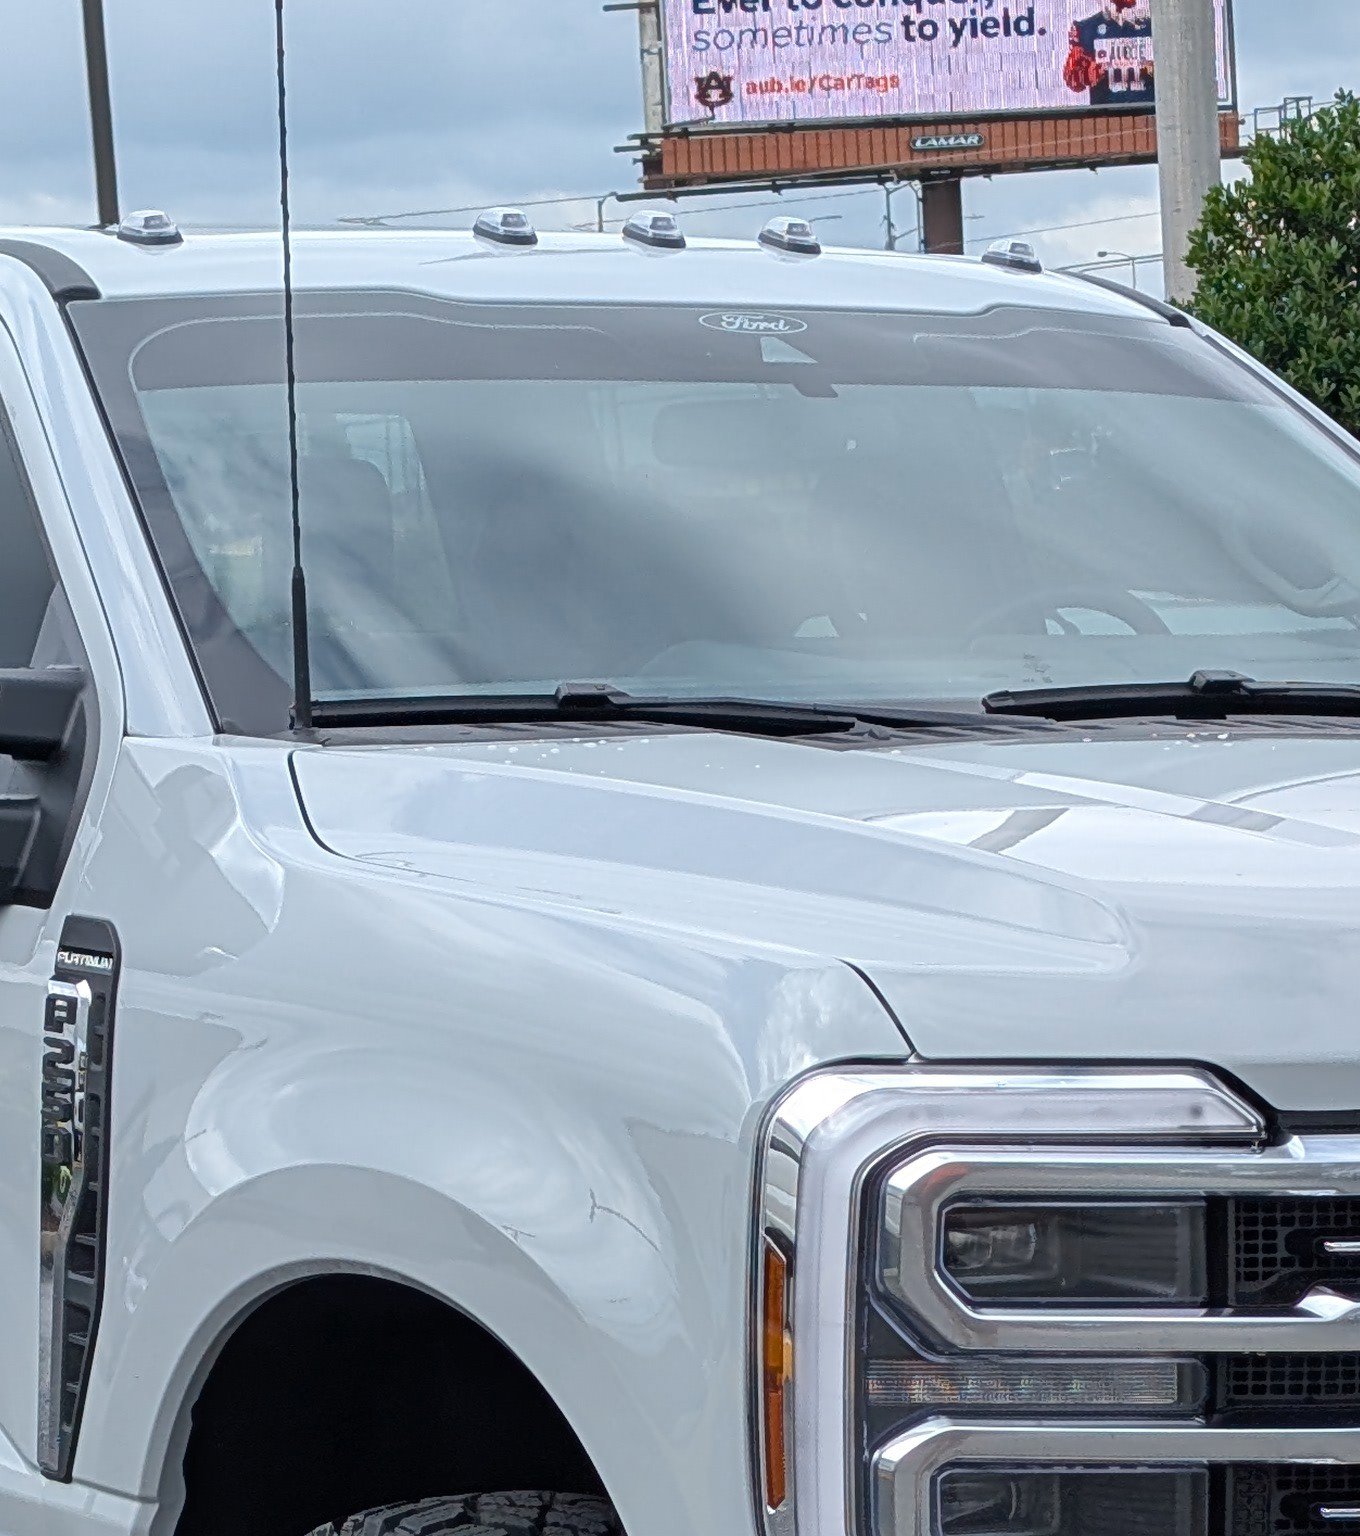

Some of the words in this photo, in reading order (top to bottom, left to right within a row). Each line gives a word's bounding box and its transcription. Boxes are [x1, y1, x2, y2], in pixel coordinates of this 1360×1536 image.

[693, 16, 892, 50] sometimes
[901, 15, 939, 42] to
[948, 7, 1046, 47] yield.
[915, 136, 979, 147] LAMAR
[720, 312, 791, 332] Ford
